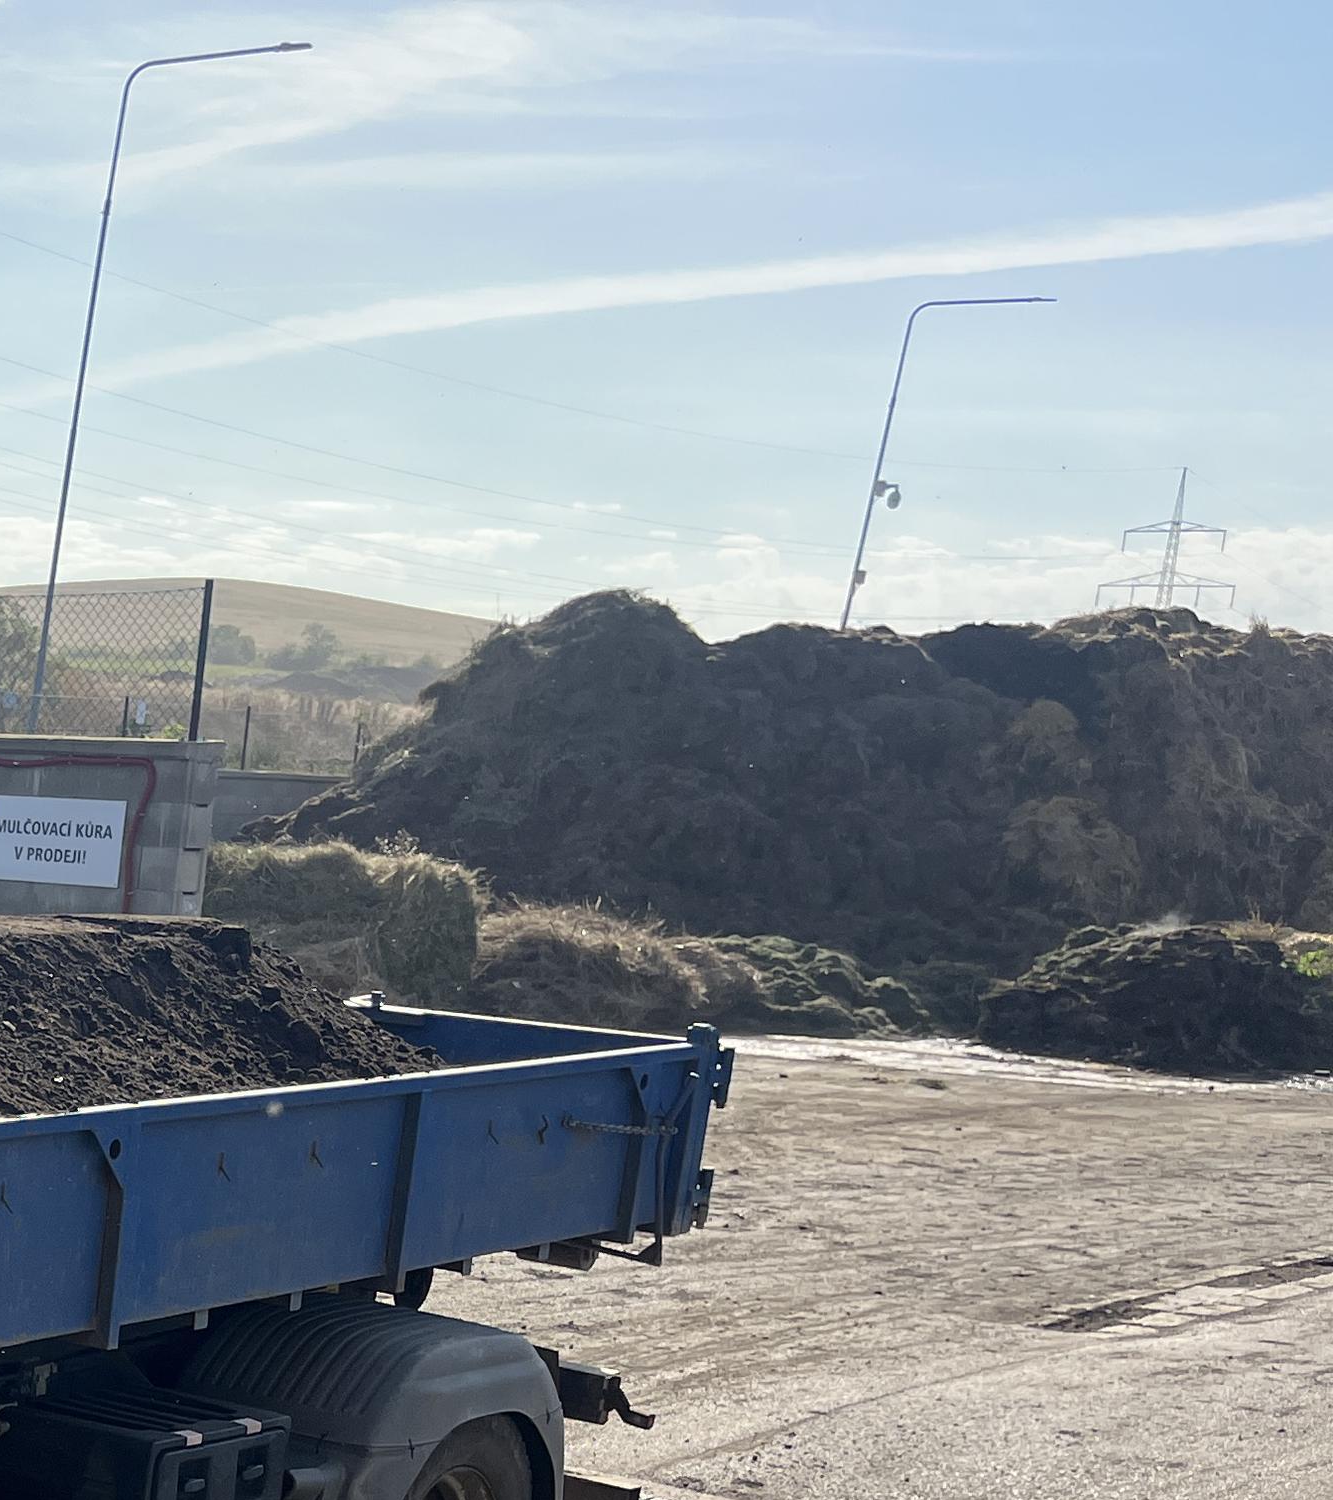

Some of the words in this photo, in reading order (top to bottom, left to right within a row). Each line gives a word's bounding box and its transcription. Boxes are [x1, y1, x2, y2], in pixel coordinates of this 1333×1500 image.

[75, 821, 113, 840] KŮRA
[14, 846, 24, 861] V
[26, 847, 87, 865] PRODEJI!
